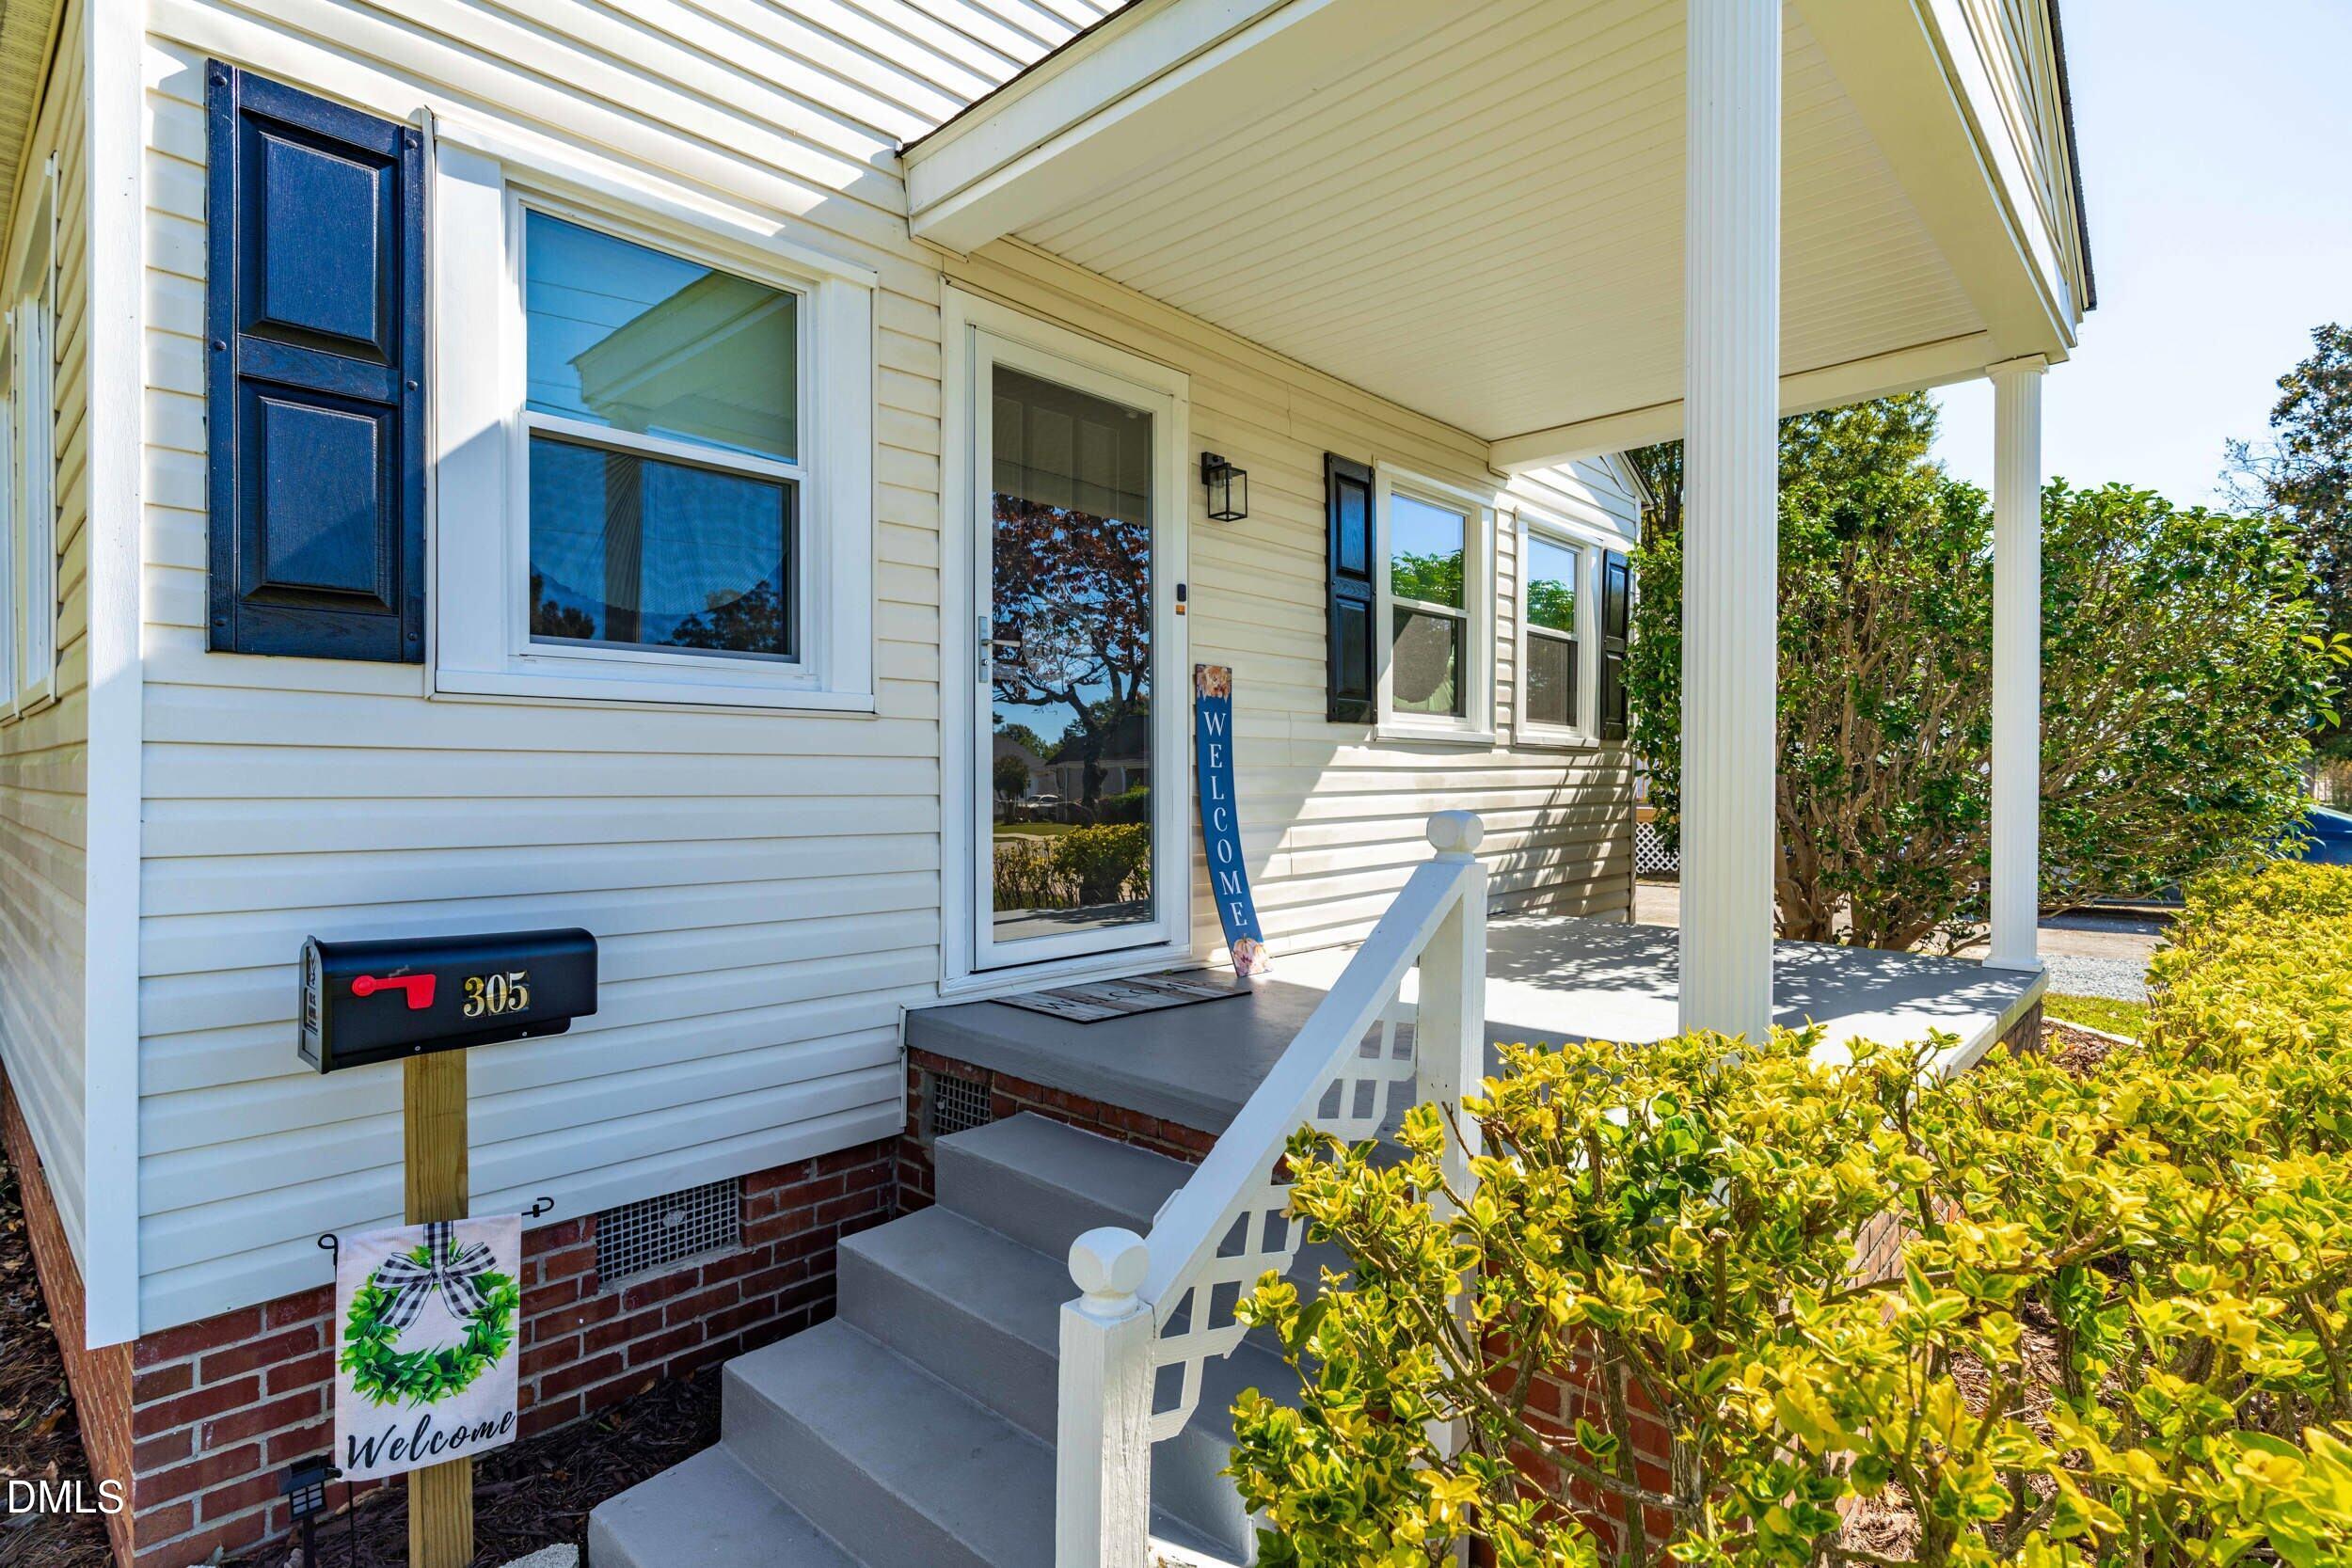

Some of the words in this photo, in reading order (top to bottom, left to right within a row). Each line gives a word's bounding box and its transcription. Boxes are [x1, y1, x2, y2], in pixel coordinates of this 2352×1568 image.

[1203, 711, 1248, 927] WELCOME
[464, 971, 528, 1018] 305
[347, 1410, 516, 1470] Welcome
